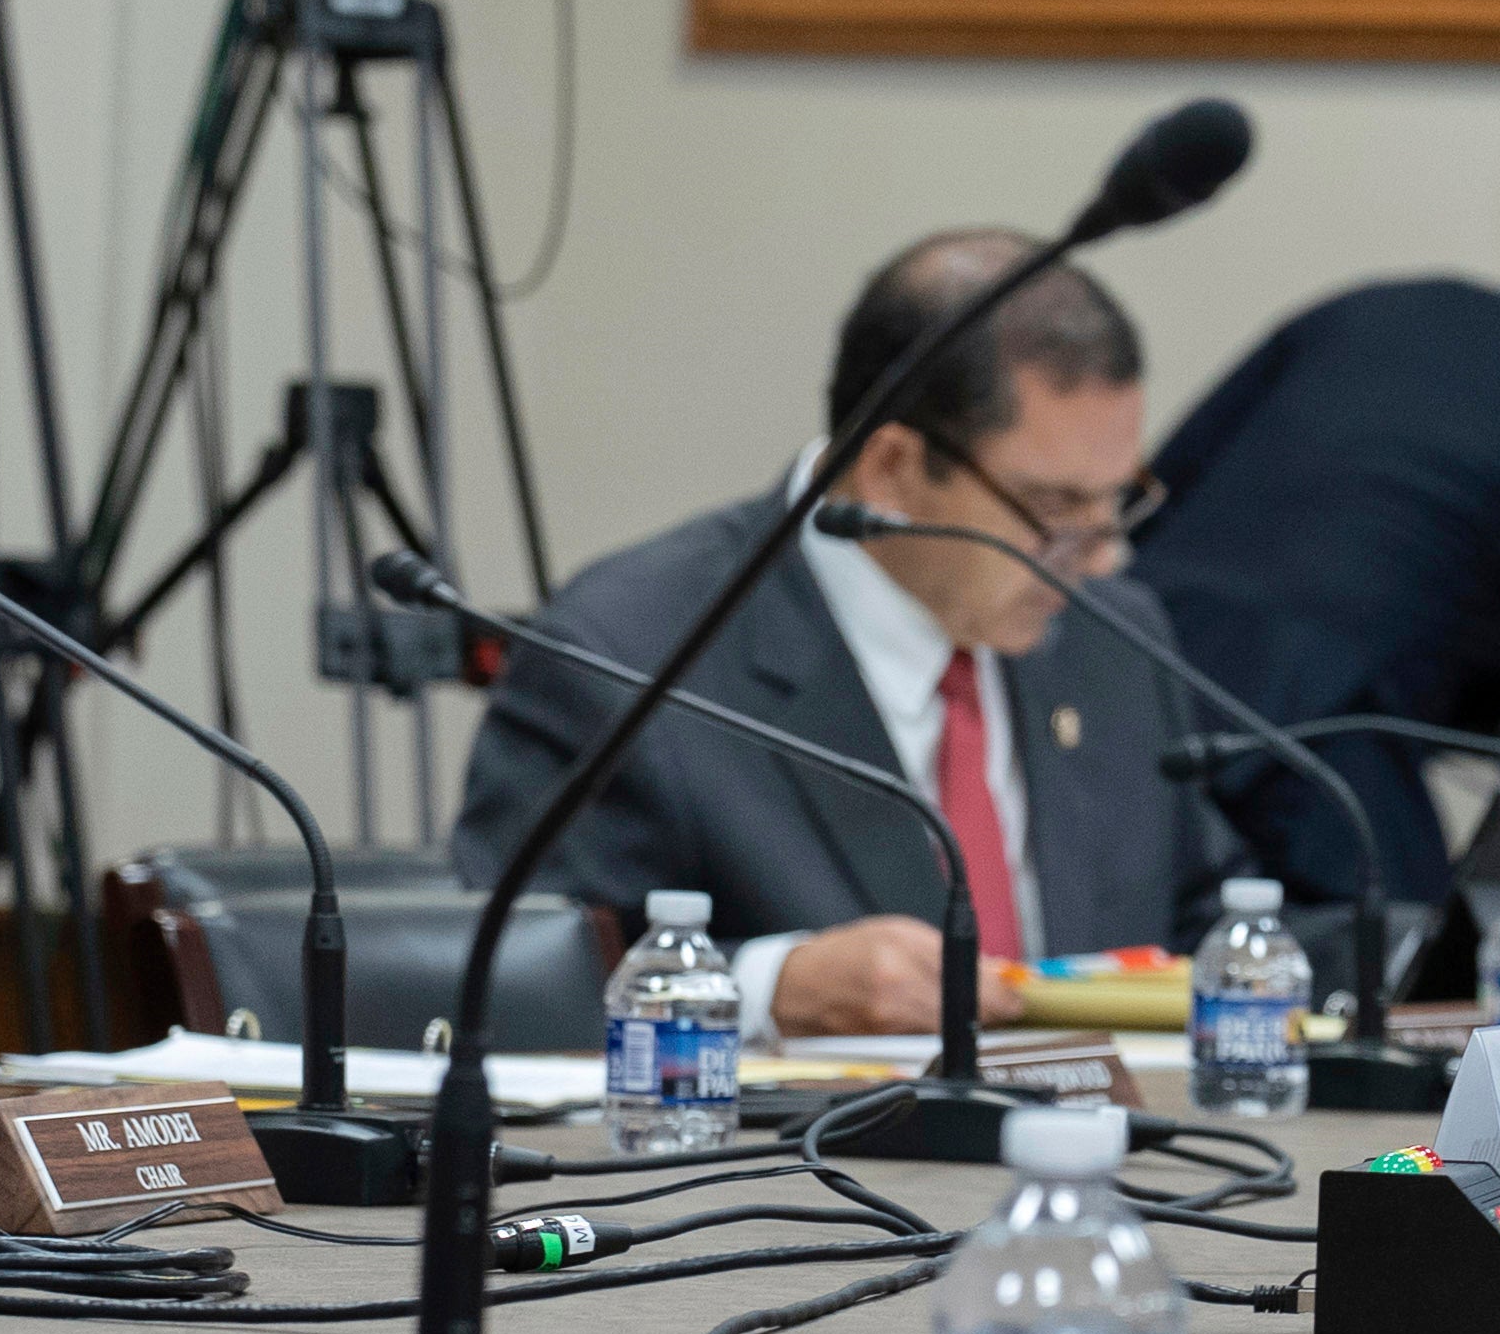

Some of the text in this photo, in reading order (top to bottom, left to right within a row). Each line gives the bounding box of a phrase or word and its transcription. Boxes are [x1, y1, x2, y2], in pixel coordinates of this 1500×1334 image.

[76, 1112, 201, 1152] MR. AMODEI
[136, 1164, 187, 1190] CHAIR
